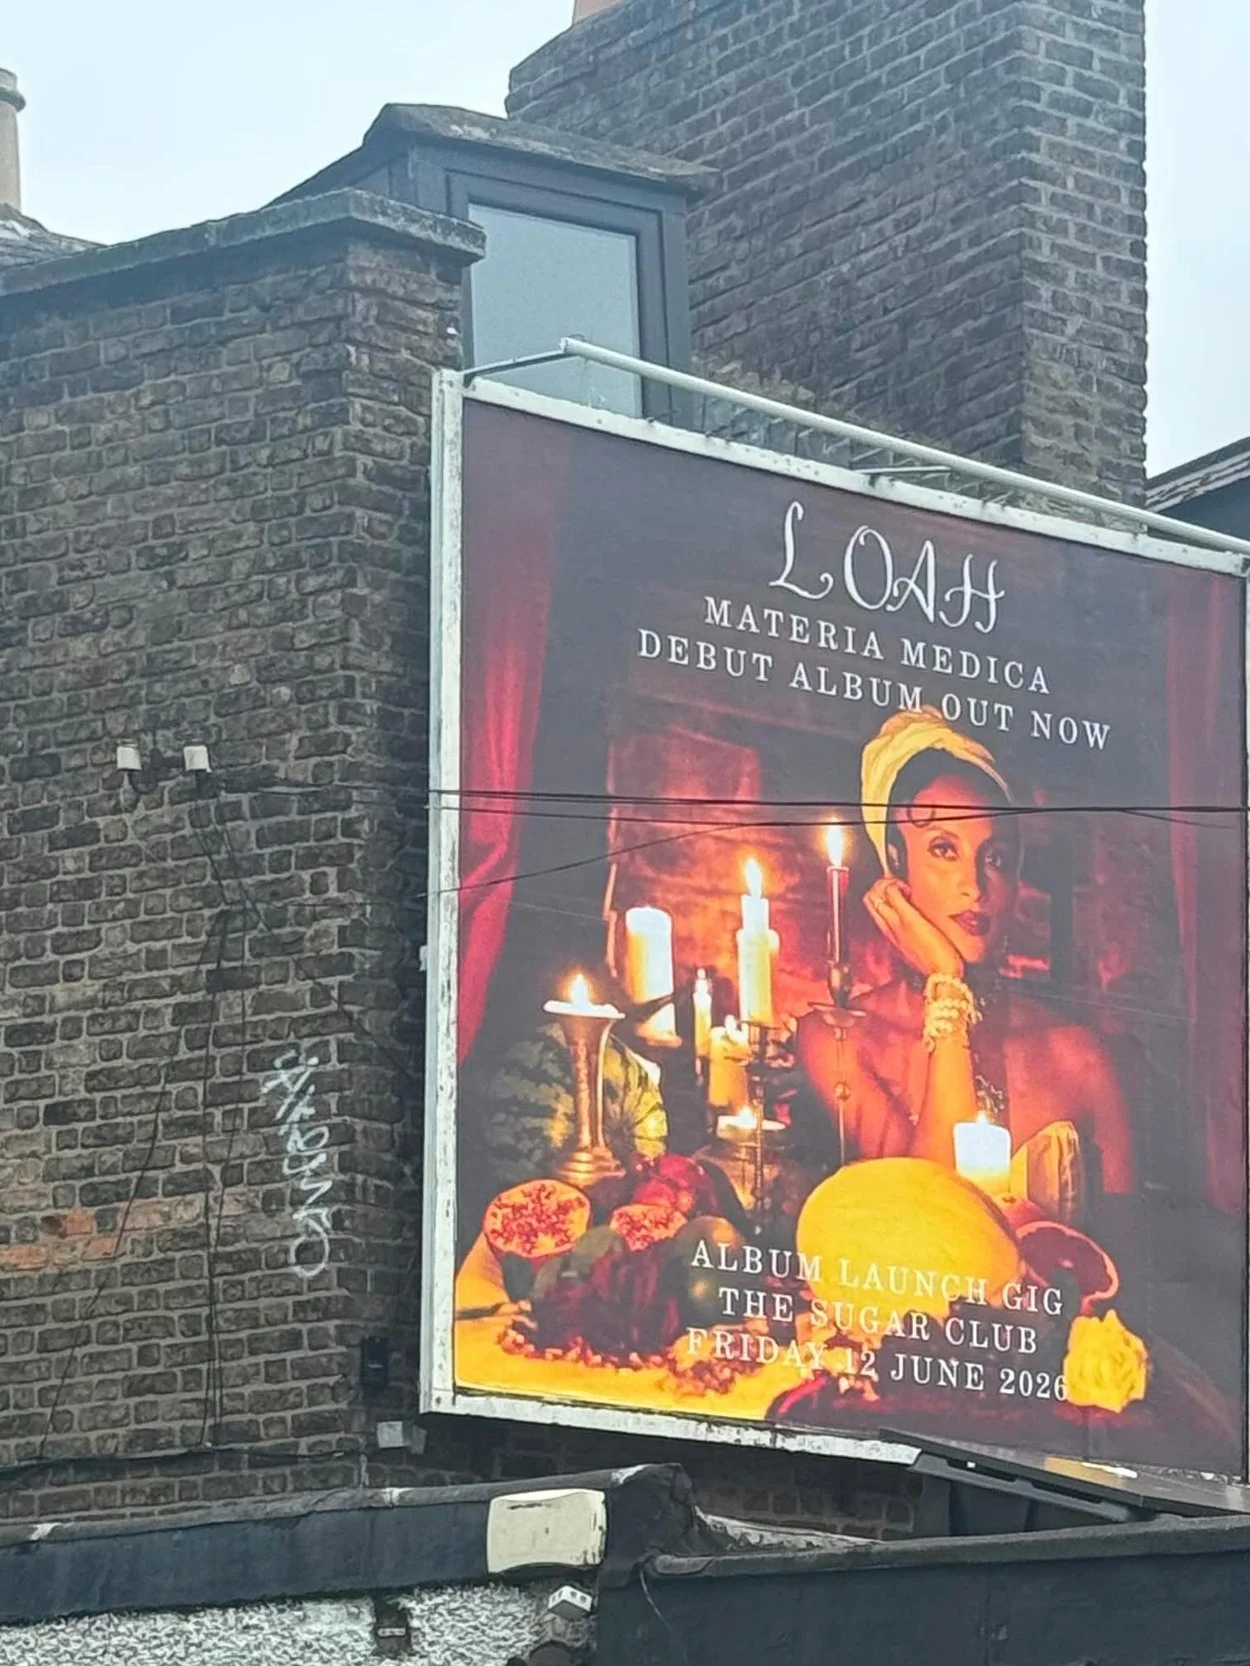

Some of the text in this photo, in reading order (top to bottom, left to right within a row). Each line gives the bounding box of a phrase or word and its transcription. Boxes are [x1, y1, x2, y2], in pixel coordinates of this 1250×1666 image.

[769, 500, 1005, 633] LOAH
[703, 596, 1050, 695] MATERIA MEDICA
[638, 628, 1113, 752] DEBUT ALBUM OUT NOW
[691, 1239, 1065, 1316] ALBUM LAUNCH GIG
[718, 1286, 1038, 1355] THE SUGAR CLUB
[686, 1326, 1067, 1401] FRIDAY 12 JUNE 2026
